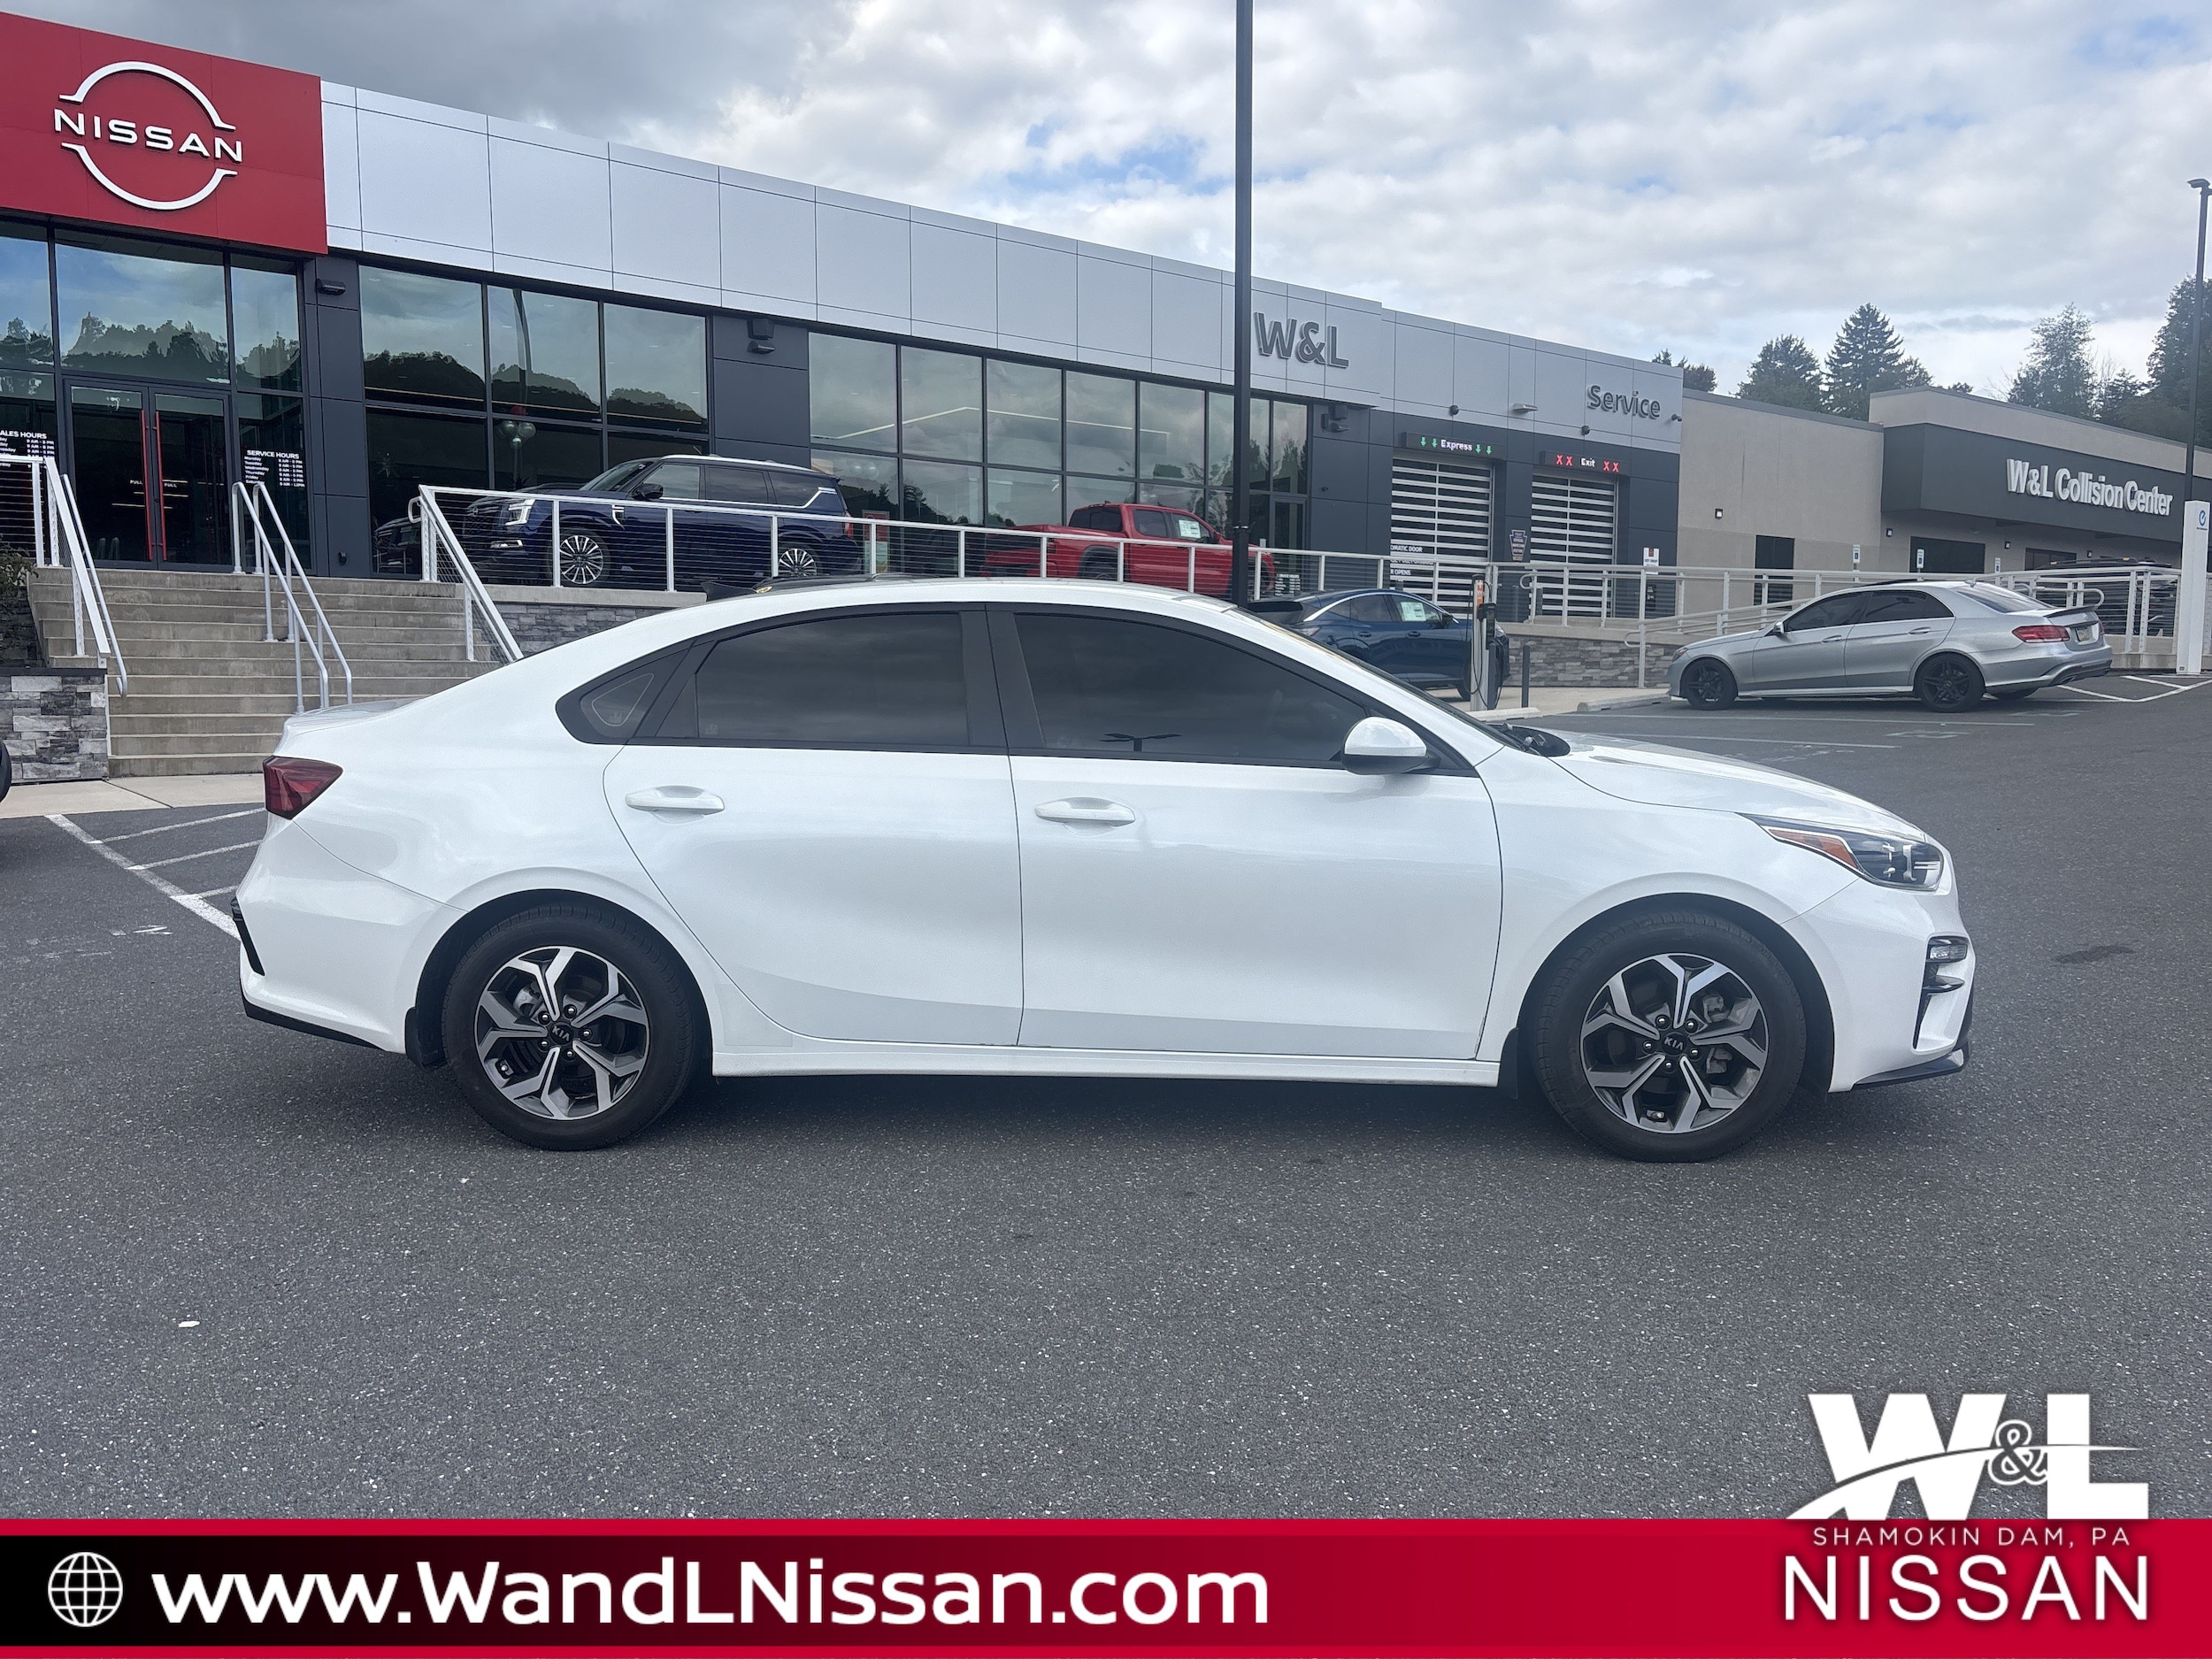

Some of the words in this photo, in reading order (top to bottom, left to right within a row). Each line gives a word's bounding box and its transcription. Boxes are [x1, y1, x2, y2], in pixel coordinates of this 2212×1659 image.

[54, 108, 242, 164] NISSAN
[1254, 311, 1349, 369] W&L
[1587, 384, 1661, 419] Service
[1440, 439, 1472, 452] Express
[1580, 457, 1595, 468] Exit
[2006, 458, 2054, 498] W&L
[2055, 467, 2124, 509] Collision
[2124, 480, 2173, 516] Center
[552, 1025, 570, 1041] KIA
[1663, 1036, 1684, 1051] KIA
